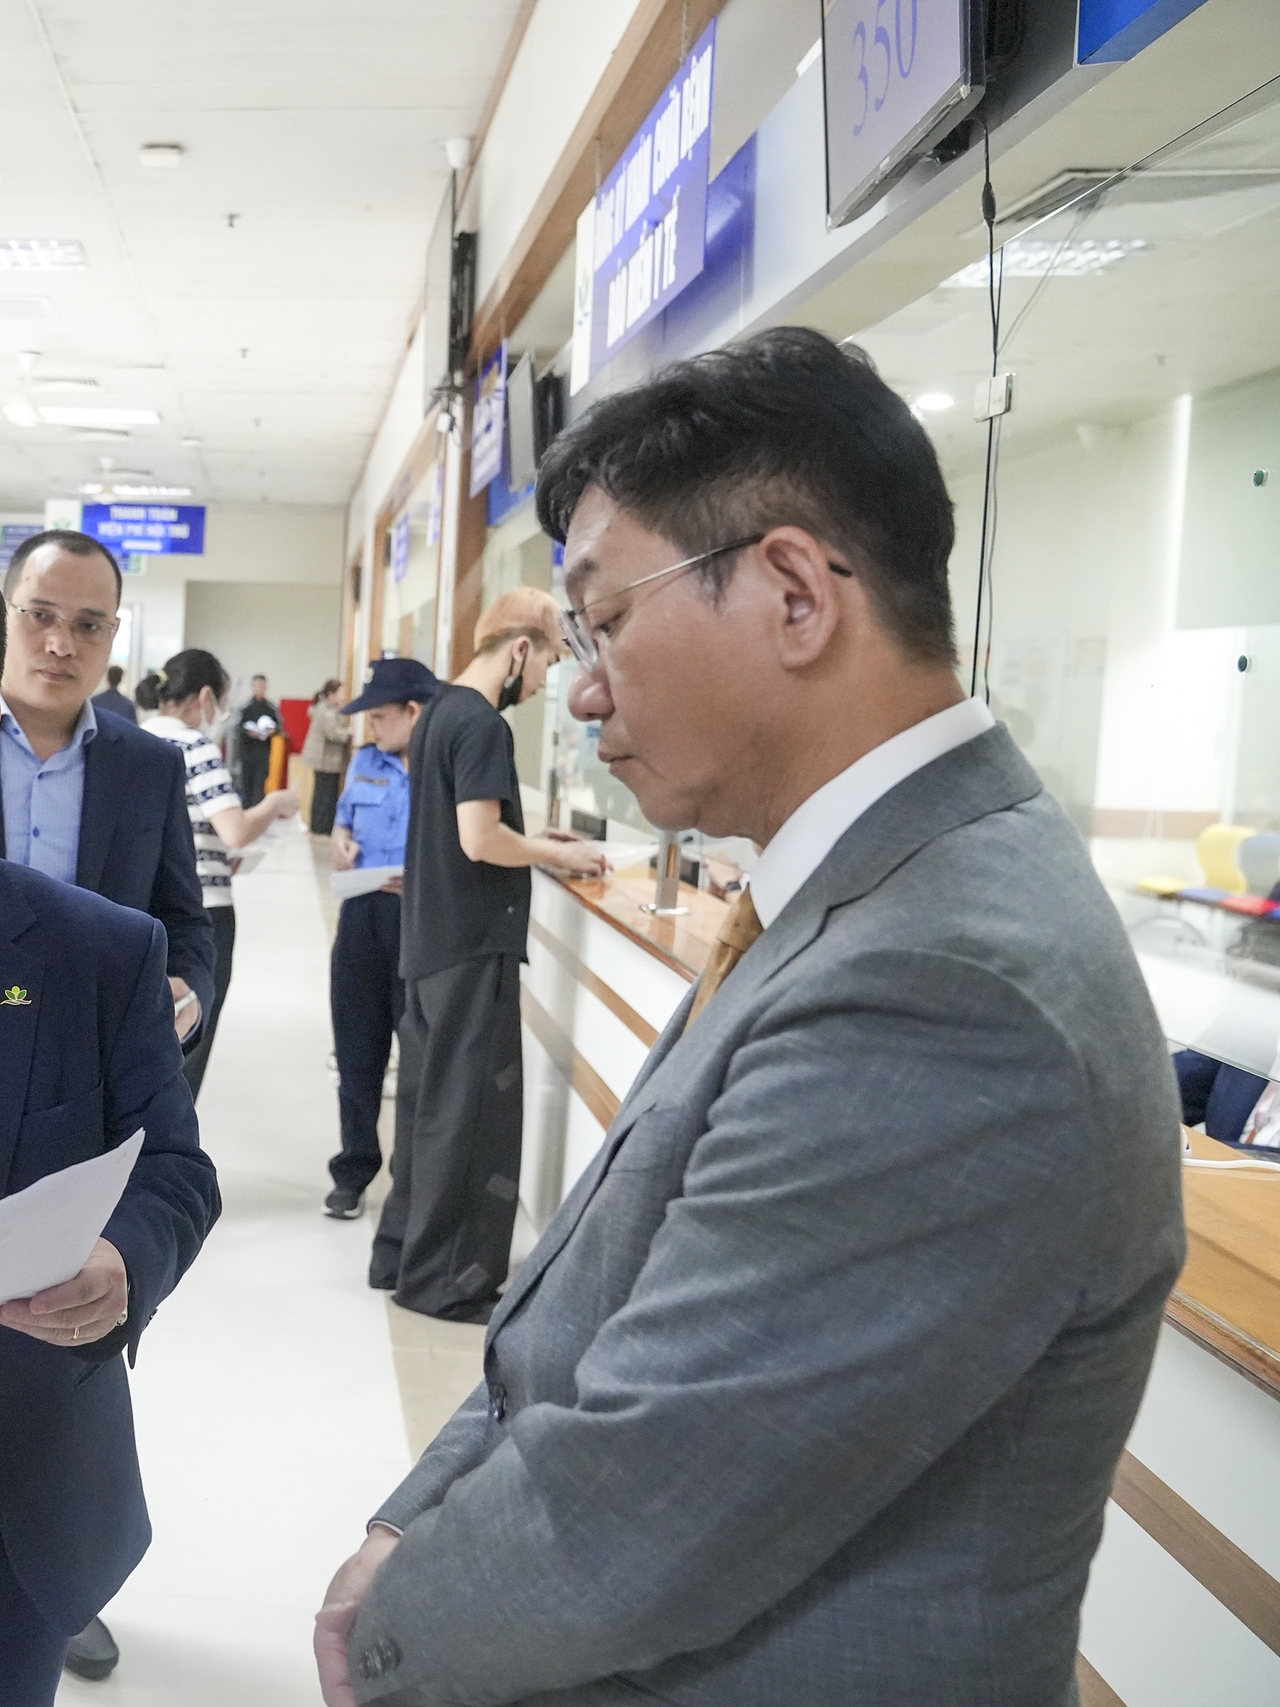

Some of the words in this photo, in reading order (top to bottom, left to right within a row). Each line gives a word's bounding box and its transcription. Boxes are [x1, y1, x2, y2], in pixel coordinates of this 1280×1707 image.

[852, 0, 918, 137] 350
[653, 222, 664, 300] Y
[662, 184, 681, 290] TẾ
